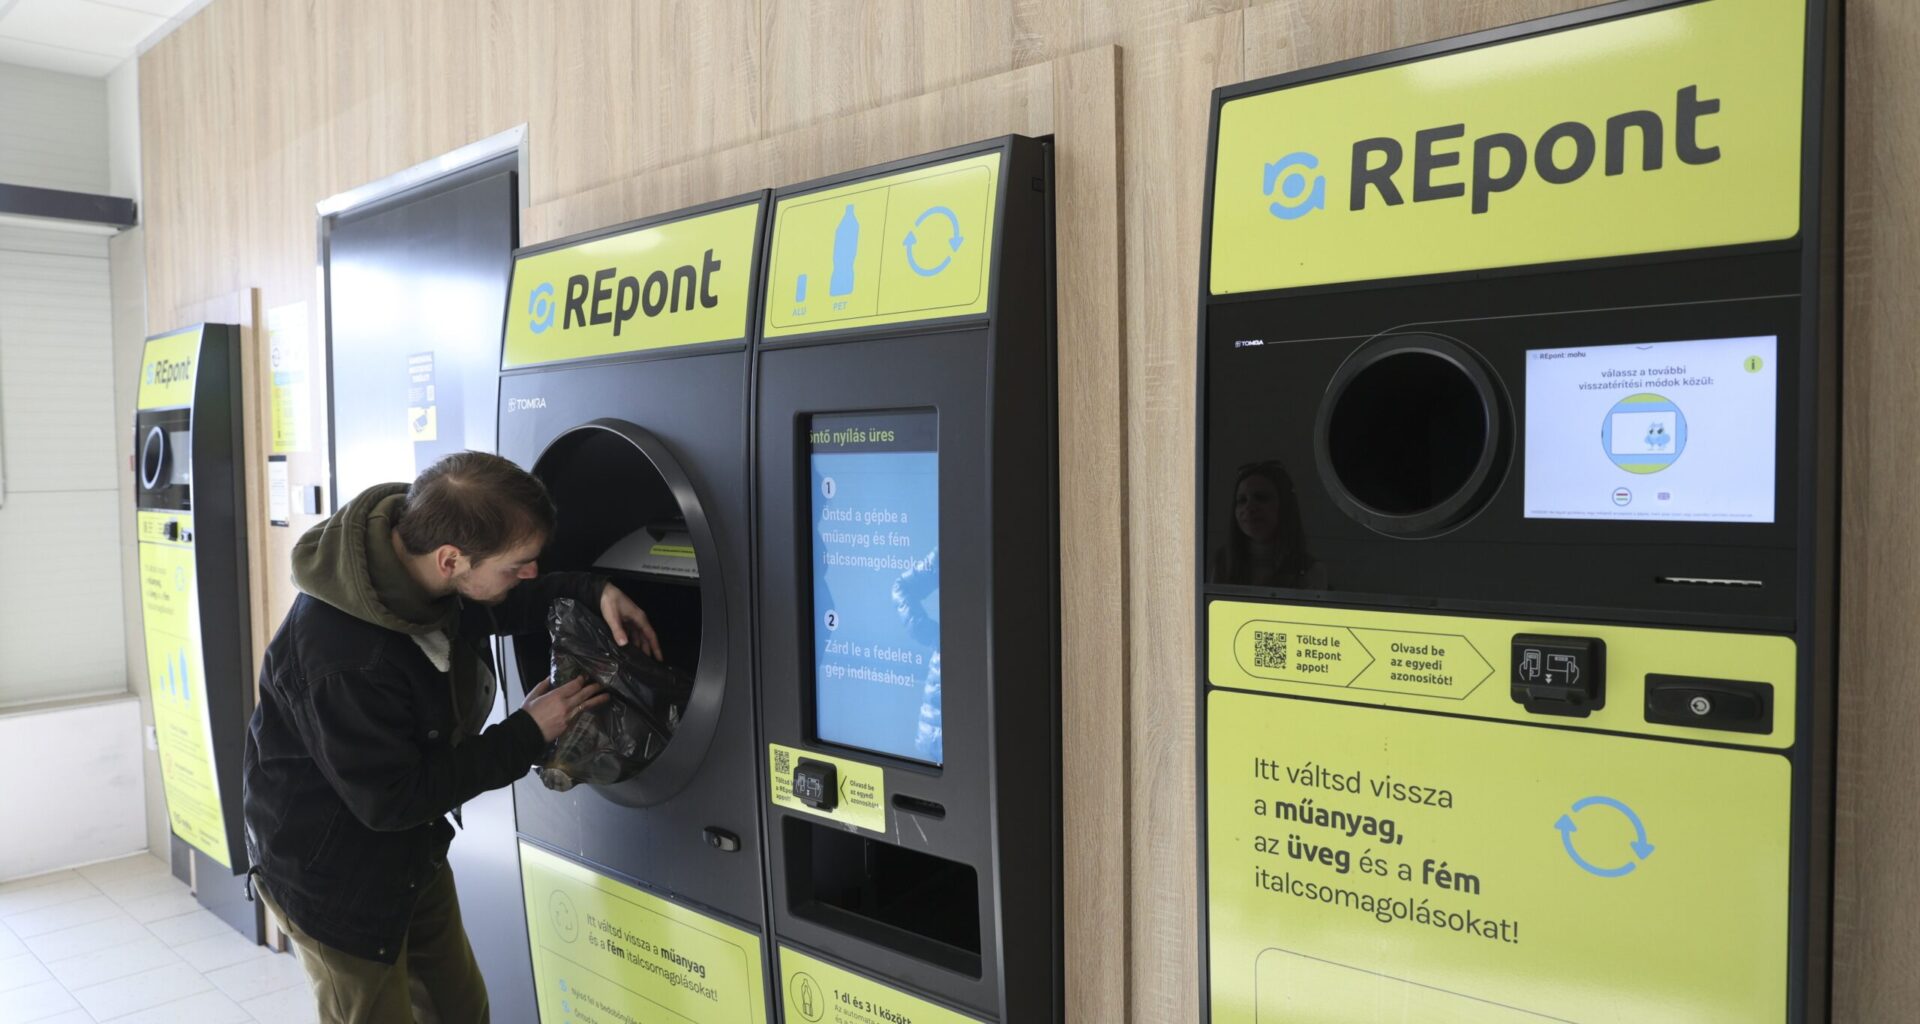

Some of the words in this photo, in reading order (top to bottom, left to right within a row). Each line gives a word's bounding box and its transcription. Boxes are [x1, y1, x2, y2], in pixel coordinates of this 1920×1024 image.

[1349, 84, 1720, 214] REpont
[563, 248, 721, 337] REpont
[1242, 339, 1264, 347] TOMRA
[155, 356, 191, 389] REpont
[1601, 367, 1637, 378] válassz
[1640, 368, 1646, 376] a
[1648, 365, 1686, 376] további
[1579, 379, 1643, 390] visszatérítési
[1645, 377, 1681, 388] módok
[517, 398, 547, 410] TOMRA
[833, 427, 866, 447] nyílás
[869, 427, 895, 442] üres
[826, 481, 831, 494] 1
[822, 505, 852, 521] Öntsd
[855, 511, 862, 521] a
[864, 508, 898, 526] gépbe
[901, 512, 908, 524] a
[822, 529, 870, 546] műanyag
[873, 531, 885, 545] és
[888, 531, 910, 547] fém
[823, 551, 932, 572] italcsomagolásokat!
[828, 614, 835, 627] 2
[1296, 634, 1328, 647] Töltsd
[1331, 637, 1340, 648] le
[1391, 642, 1428, 656] Olvasd
[1431, 645, 1445, 657] be
[825, 640, 849, 655] Zárd
[851, 643, 860, 657] le
[864, 646, 871, 658] a
[873, 645, 912, 664] fedelet
[916, 653, 922, 665] a
[1296, 648, 1302, 658] a
[1305, 649, 1342, 662] REpont
[1296, 662, 1329, 674] appot!
[1391, 657, 1403, 667] az
[1406, 659, 1442, 672] egyedi
[826, 664, 845, 679] gép
[848, 665, 914, 688] indításához!
[1391, 671, 1453, 686] azonosítót!
[850, 780, 867, 790] Olvasd
[1254, 757, 1280, 782] Itt
[1287, 762, 1361, 794] váltsd
[1370, 775, 1453, 809] vissza
[1254, 798, 1267, 816] a
[1275, 798, 1404, 845] műanyag,
[1254, 835, 1279, 855] az
[1287, 834, 1350, 874] üveg
[1359, 848, 1388, 877] és
[1397, 863, 1412, 882] a
[1422, 859, 1480, 895] fém
[1255, 866, 1519, 943] italcsomagolásokat!
[587, 913, 596, 927] Itt
[597, 919, 622, 939] váltsd
[623, 930, 651, 952] vissza
[653, 944, 658, 956] a
[661, 947, 706, 979] műanyag
[589, 931, 599, 946] és
[600, 939, 606, 949] a
[607, 939, 625, 959] fém
[627, 949, 718, 1002] italcsomagolásokat!
[834, 989, 839, 999] 1
[841, 992, 851, 1005] dl
[853, 996, 863, 1010] és
[865, 1001, 871, 1013] 3
[879, 1006, 912, 1024] között
